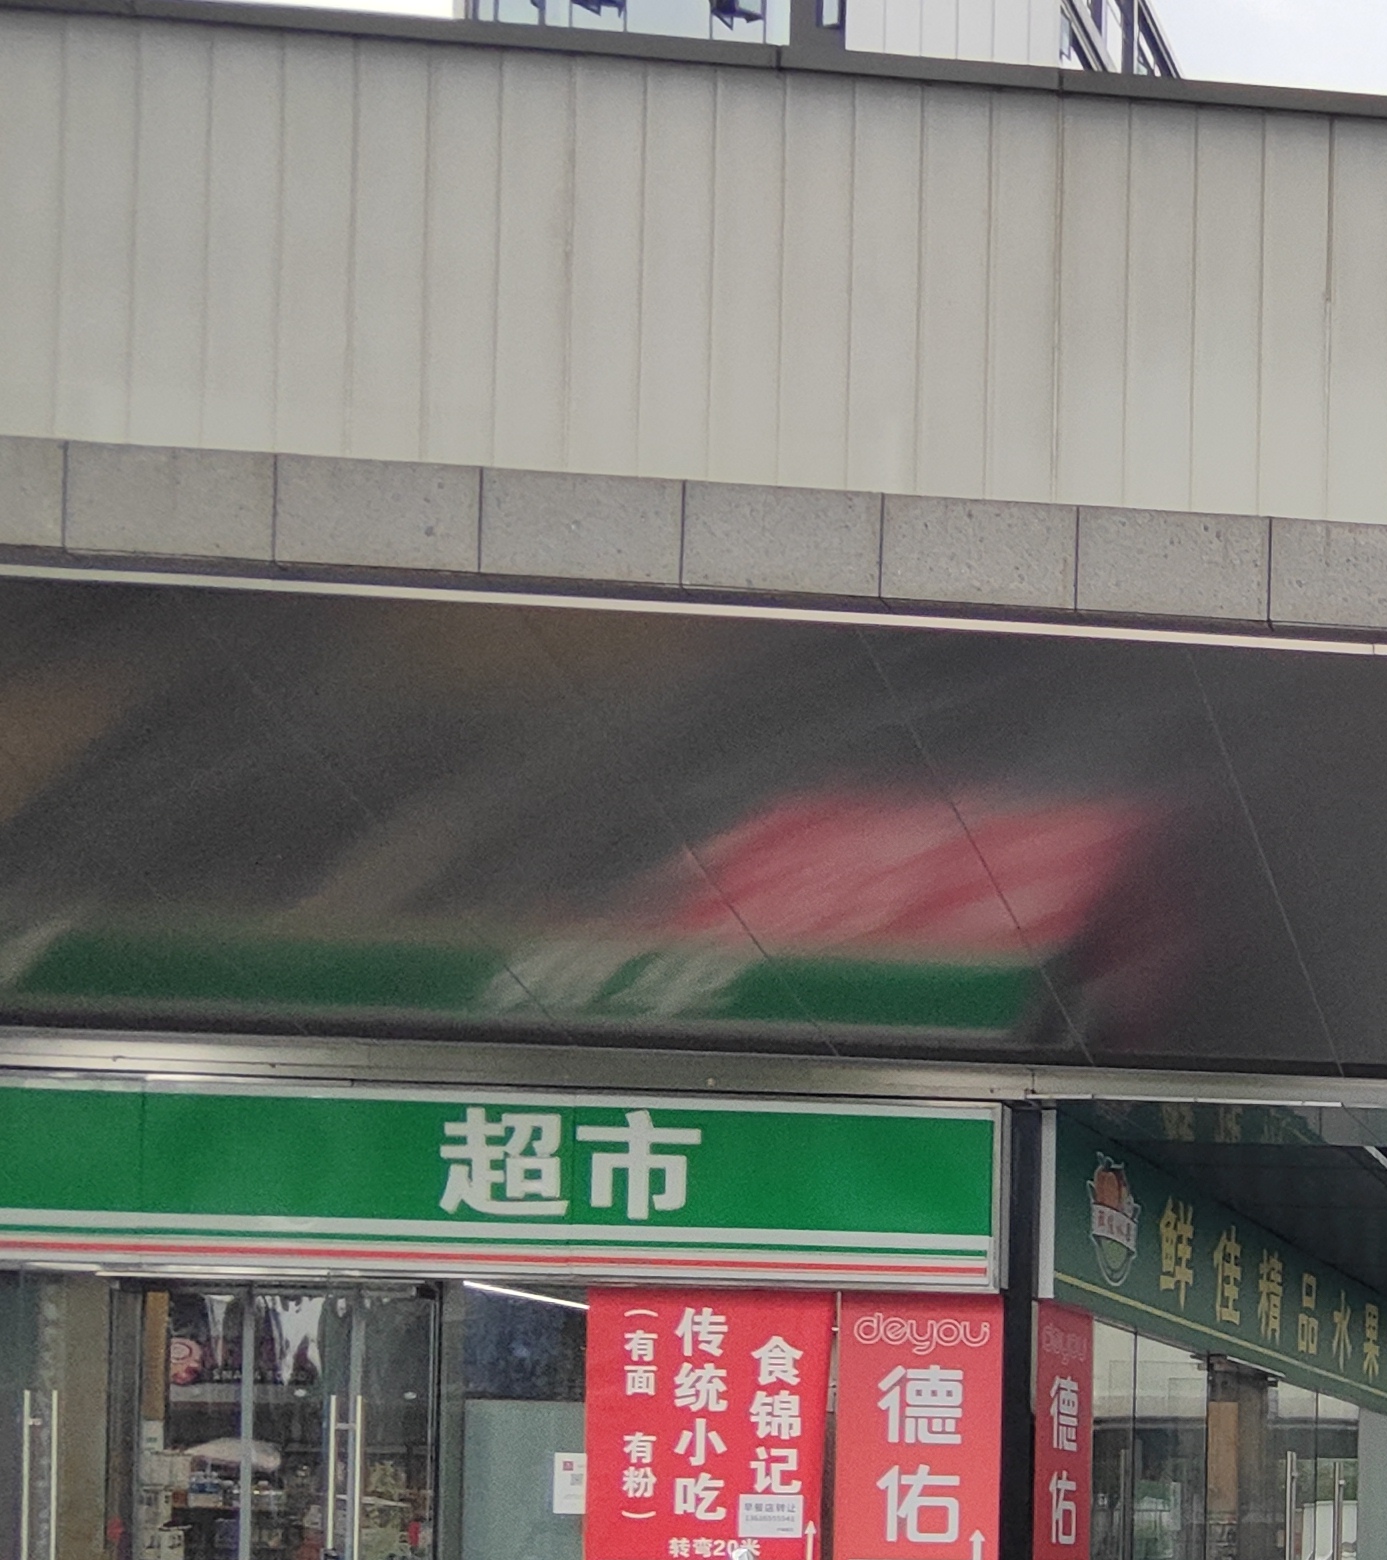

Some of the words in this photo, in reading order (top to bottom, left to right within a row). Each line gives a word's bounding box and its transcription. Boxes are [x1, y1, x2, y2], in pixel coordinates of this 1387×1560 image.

[439, 1107, 702, 1220] 超市
[854, 1312, 991, 1355] deyou
[674, 1307, 729, 1521] 传统小吃
[749, 1336, 803, 1494] 食锦记
[876, 1365, 964, 1543] 德佑
[1049, 1375, 1079, 1545] 德佑
[668, 1537, 761, 1558] 转弯20米
